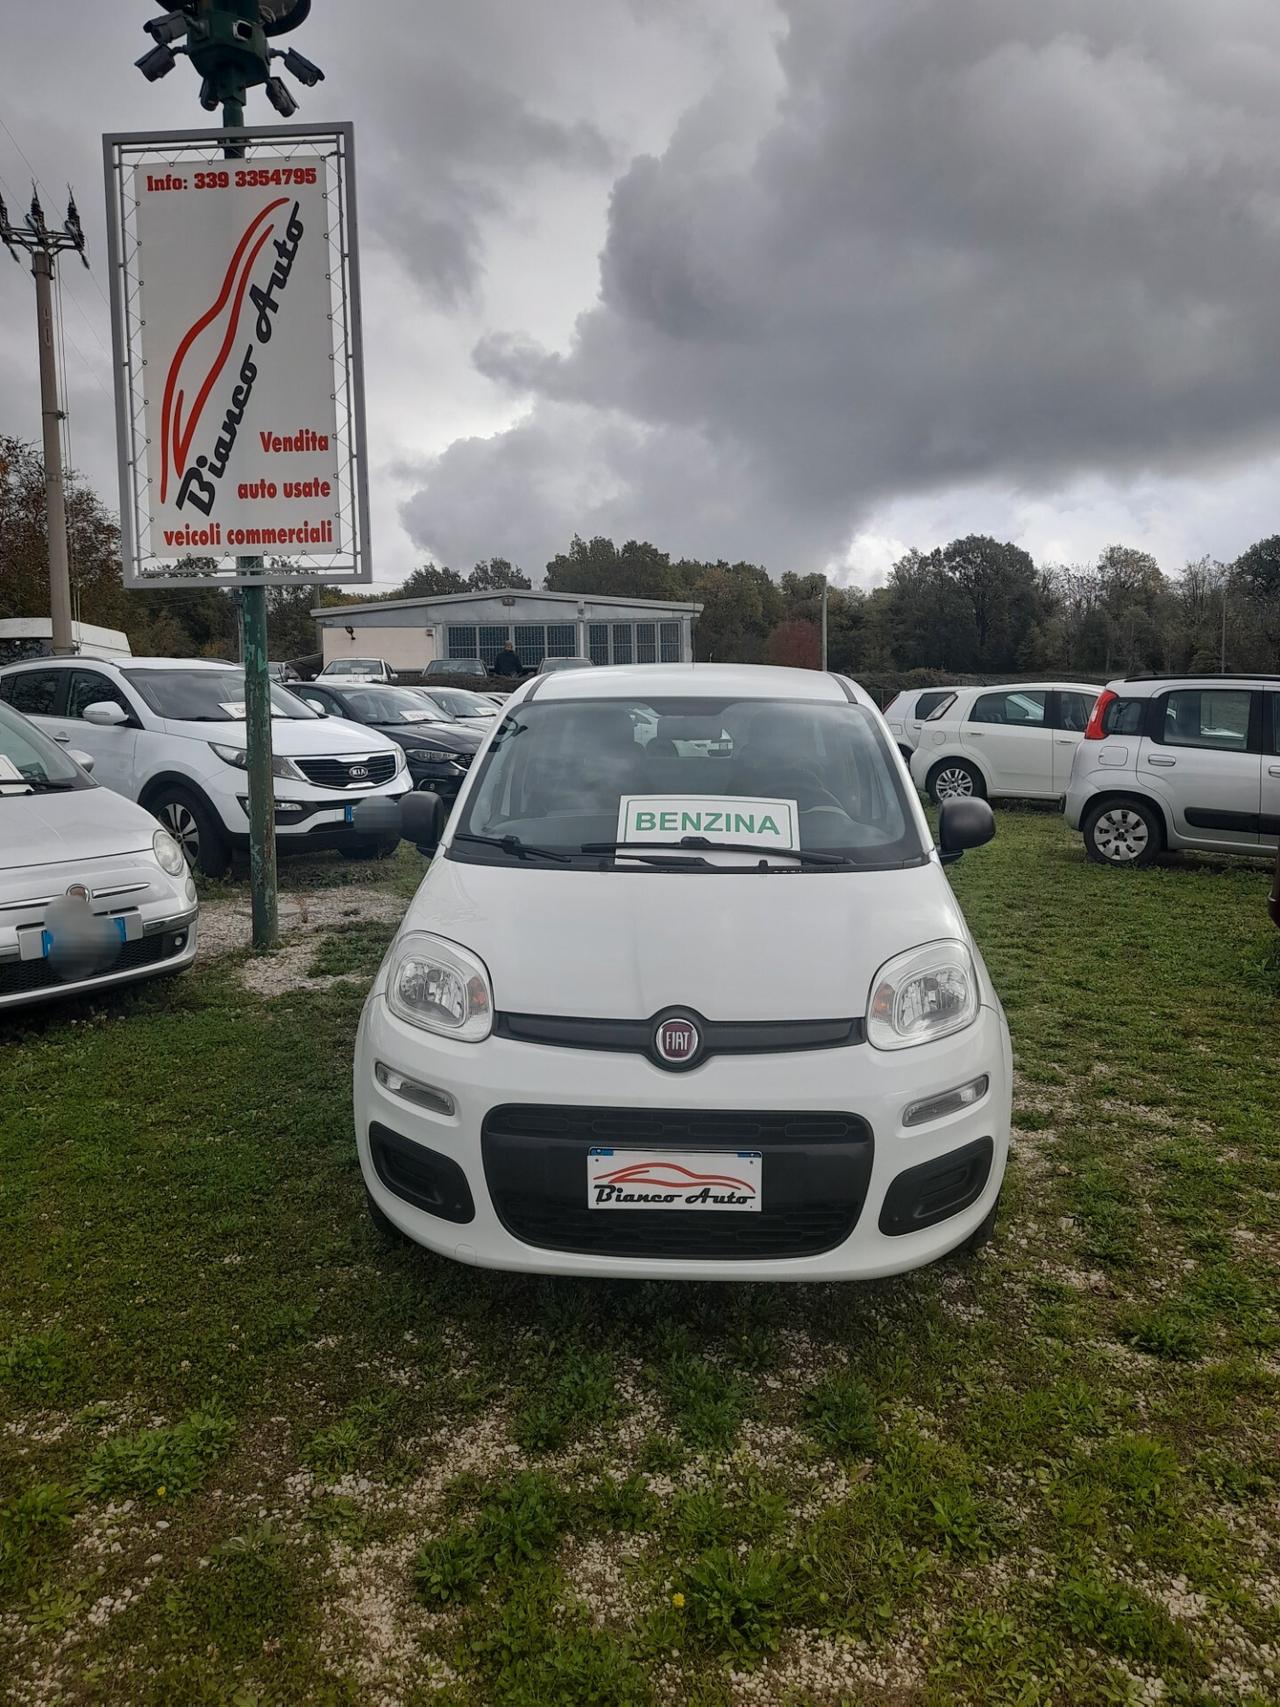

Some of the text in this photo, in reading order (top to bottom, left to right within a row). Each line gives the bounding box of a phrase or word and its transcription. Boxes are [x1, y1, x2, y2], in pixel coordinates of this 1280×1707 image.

[146, 168, 317, 192] Info: 339 3354795
[175, 201, 304, 517] Bianco Auto
[260, 429, 329, 452] Vendita
[237, 478, 331, 499] auto usate
[164, 520, 333, 546] veicoli commerciali
[635, 811, 780, 835] BENZINA
[666, 1031, 690, 1050] FIAT
[593, 1184, 756, 1205] Bianco Auto
